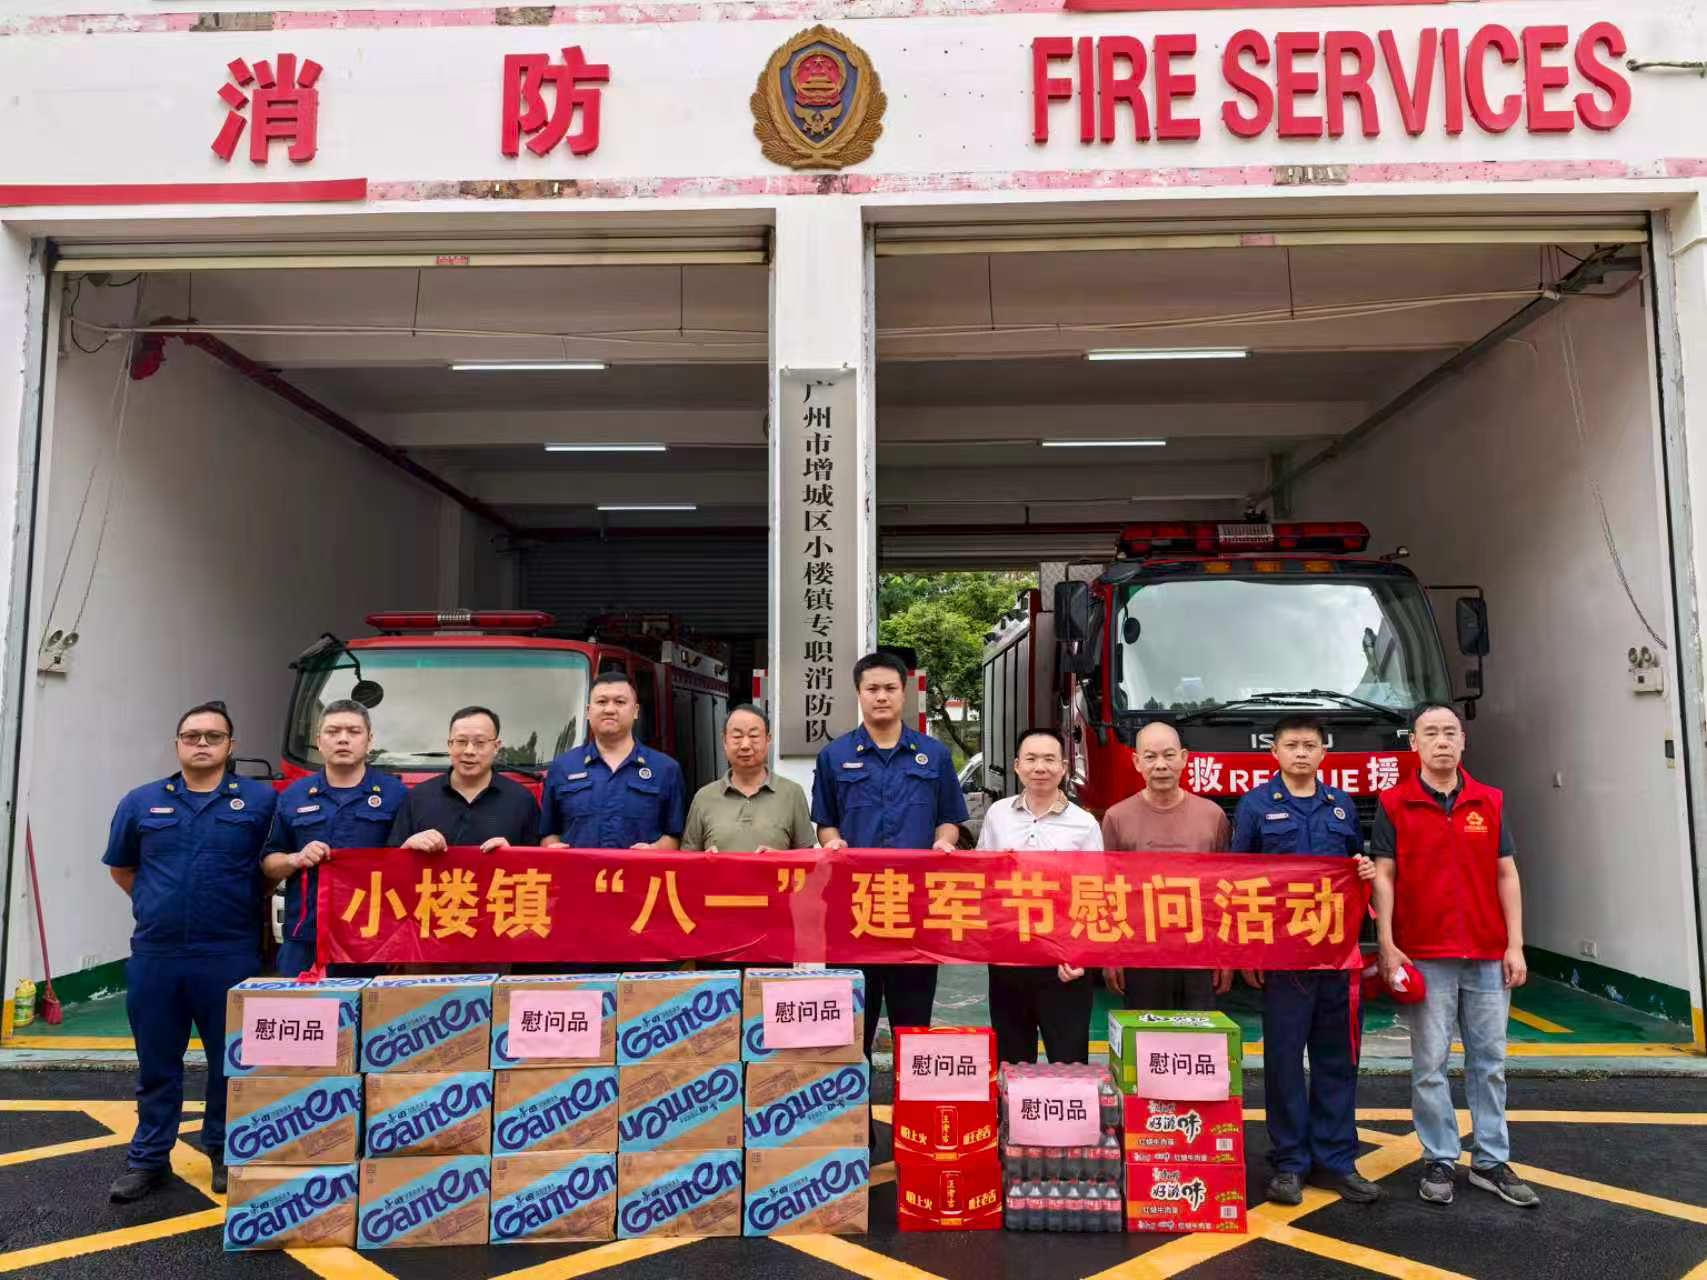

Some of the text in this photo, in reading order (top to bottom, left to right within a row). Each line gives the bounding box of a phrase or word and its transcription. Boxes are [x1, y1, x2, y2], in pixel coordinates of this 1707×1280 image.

[1031, 21, 1632, 144] FIRE SERVICES
[212, 45, 610, 165] 消防
[801, 380, 834, 742] 广州市增城区小楼镇专职消防队
[1187, 755, 1400, 793] 救 REUE 援
[341, 868, 552, 939] 小楼镇
[849, 867, 1345, 945] 建军节慰问活动
[521, 1010, 588, 1033] 慰问品
[775, 1000, 841, 1024] 慰问品
[255, 1018, 324, 1042] 慰问品
[911, 1054, 977, 1077] 慰问品
[1149, 1051, 1216, 1076] 慰问品
[1020, 1097, 1088, 1122] 慰问品
